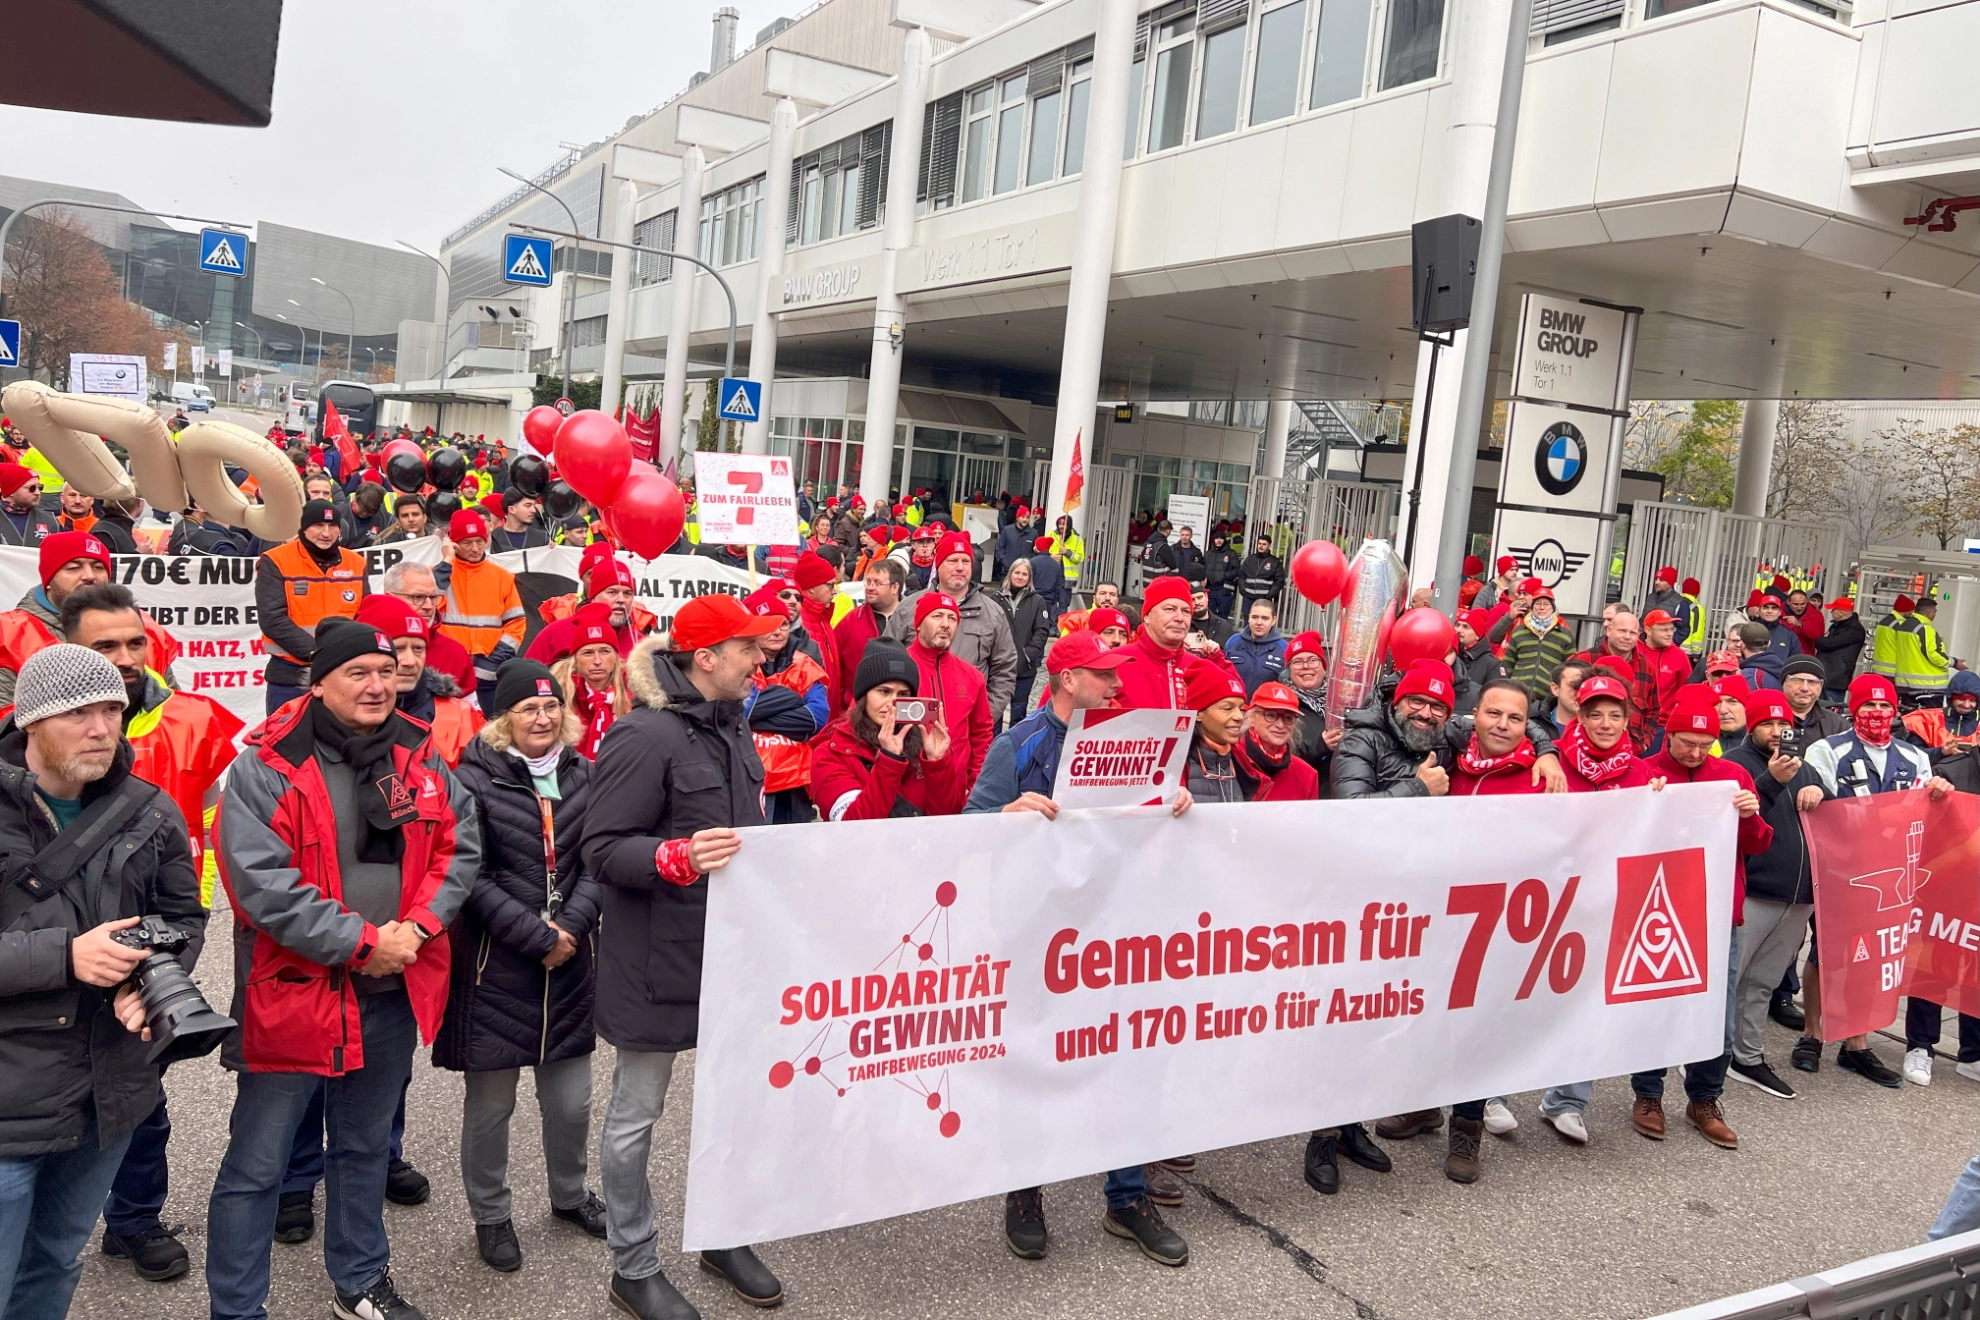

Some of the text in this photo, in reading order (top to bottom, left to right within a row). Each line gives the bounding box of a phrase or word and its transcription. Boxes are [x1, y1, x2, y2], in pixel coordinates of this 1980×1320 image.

[922, 249, 960, 281] Werk
[966, 238, 990, 274] 1.1
[995, 233, 1024, 269] Tor
[783, 265, 861, 304] BMW GROUP
[1539, 308, 1586, 335] BMW
[1537, 330, 1599, 359] GROUP
[1534, 359, 1573, 377] Werk 1.1
[1533, 375, 1555, 390] Tor 1
[1543, 423, 1586, 450] BMW
[702, 493, 792, 507] ZUM FAIRLIEBEN
[198, 557, 254, 585] MU
[1534, 557, 1562, 573] MINI
[194, 606, 239, 625] DER
[188, 641, 246, 659] HATZ,
[192, 670, 248, 691] JETZT
[1074, 737, 1161, 755] SOLIDARITÄT
[1070, 756, 1157, 777] GEWINNT
[1069, 777, 1149, 787] TARIFBEWEGUNG JETZT
[1446, 875, 1586, 1011] 7%
[1876, 922, 1909, 957] TEA
[1928, 911, 1980, 952] ME
[1043, 902, 1431, 994] Gemeinsam für
[779, 953, 1012, 1025] SOLIDARITÄT
[849, 1001, 1008, 1059] GEWINNT
[1055, 979, 1425, 1063] und 170 Euro für Azubis
[847, 1043, 1007, 1083] TARIFBEWEGUNG 2024
